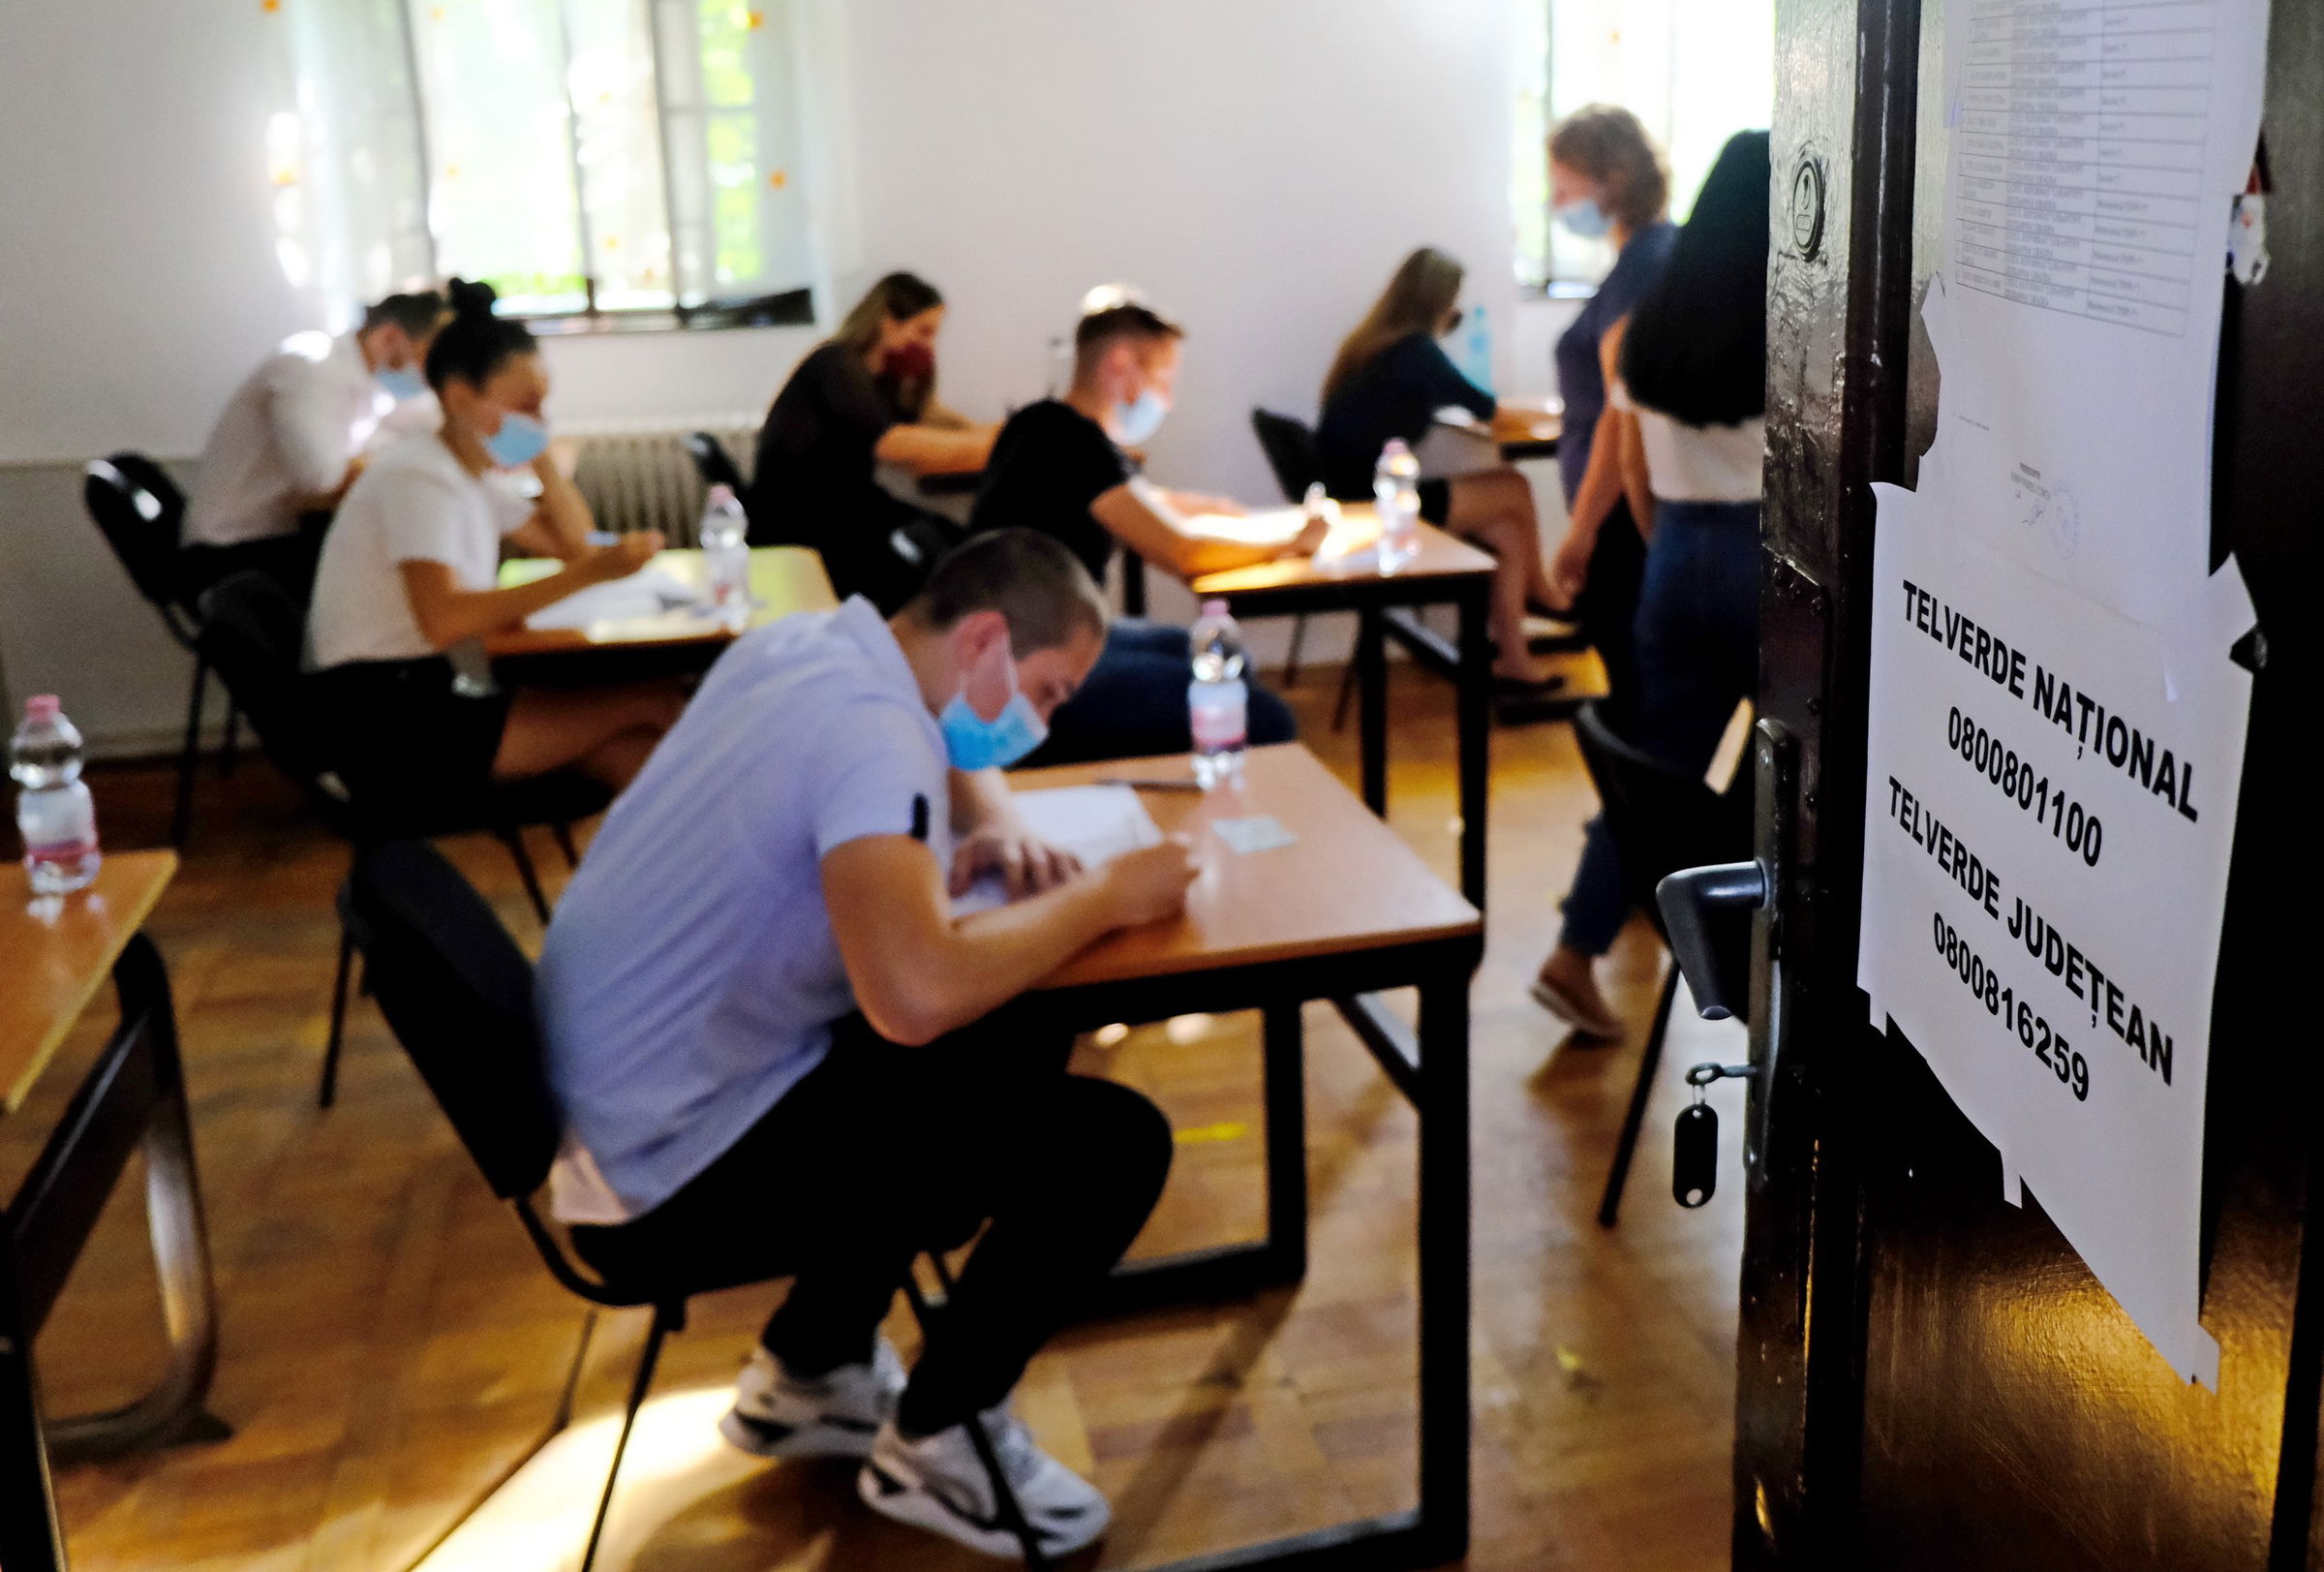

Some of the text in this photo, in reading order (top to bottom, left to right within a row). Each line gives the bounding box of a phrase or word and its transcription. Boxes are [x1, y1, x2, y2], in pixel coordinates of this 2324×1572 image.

[1903, 579, 2198, 823] TELVERDE NAȚIONAL
[1948, 706, 2102, 868] 0800801100
[1888, 775, 2173, 1087] TELVERDE JUDEȚEAN
[1933, 911, 2090, 1102] 0800816259
